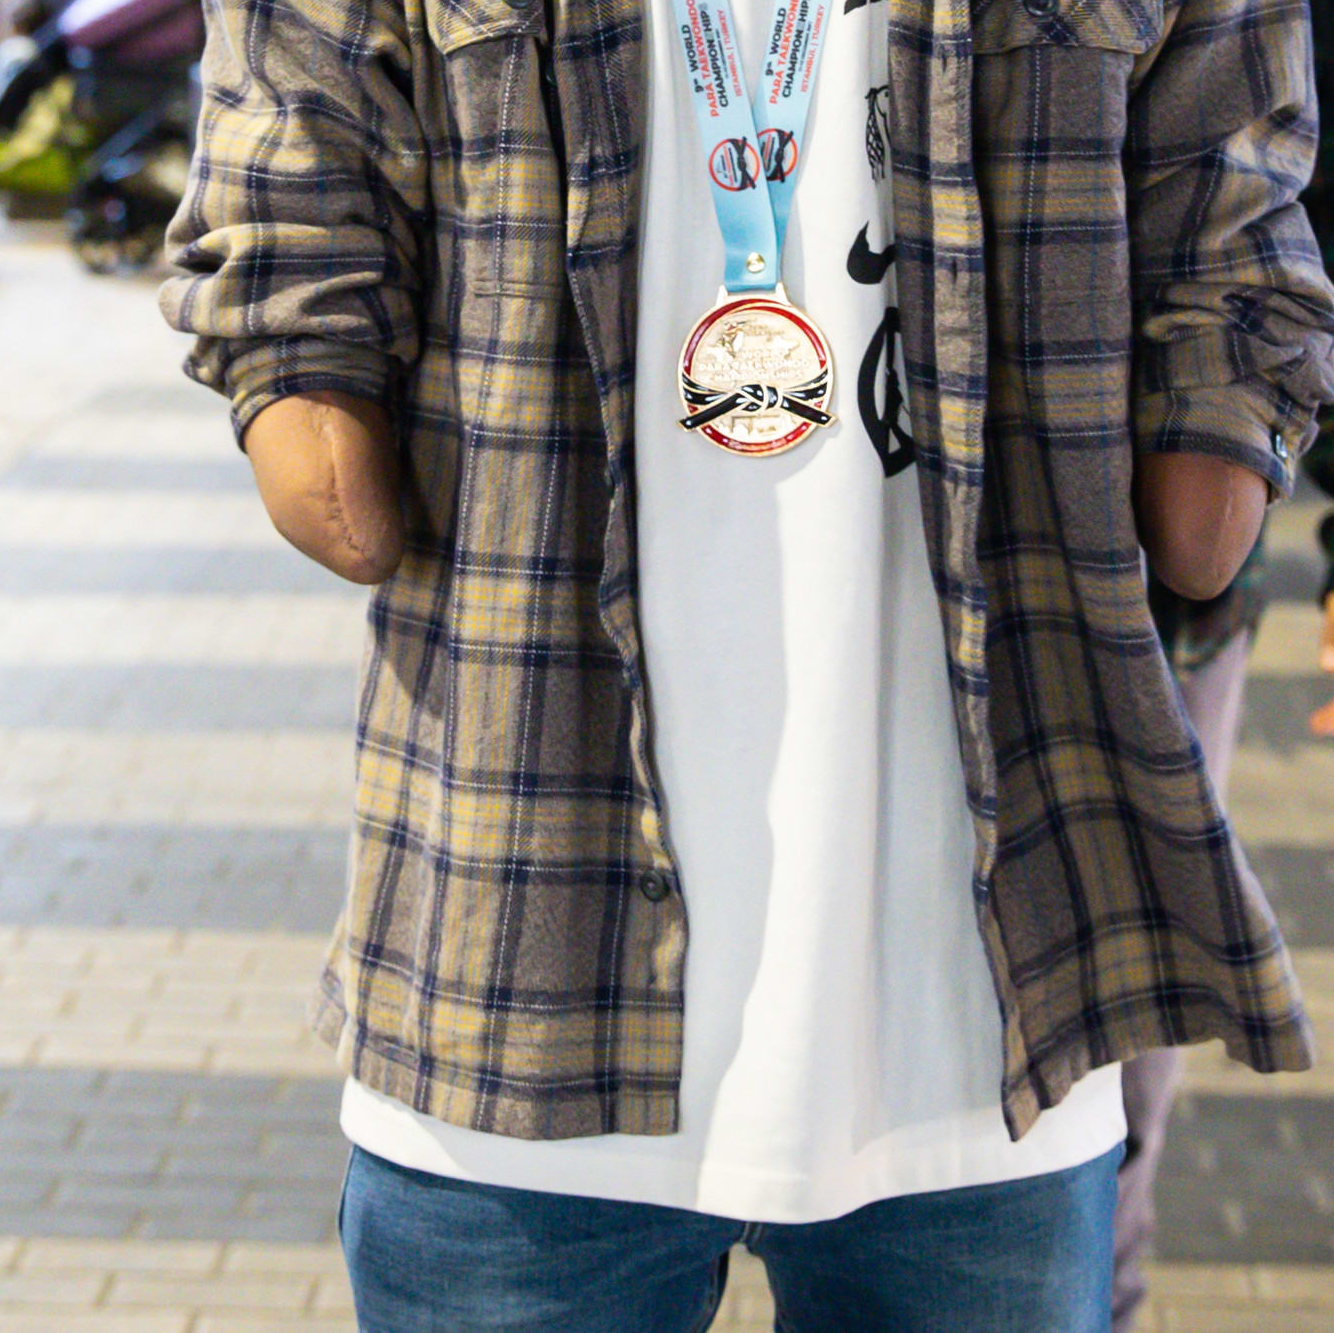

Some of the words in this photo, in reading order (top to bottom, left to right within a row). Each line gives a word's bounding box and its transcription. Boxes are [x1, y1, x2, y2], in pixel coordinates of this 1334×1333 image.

[769, 7, 786, 55] WORLD
[811, 4, 825, 41] TURKEY
[682, 24, 698, 73] WORLD
[699, 2, 728, 107] CHAMPIONHIP
[704, 82, 719, 117] PARA
[769, 70, 784, 104] PARA
